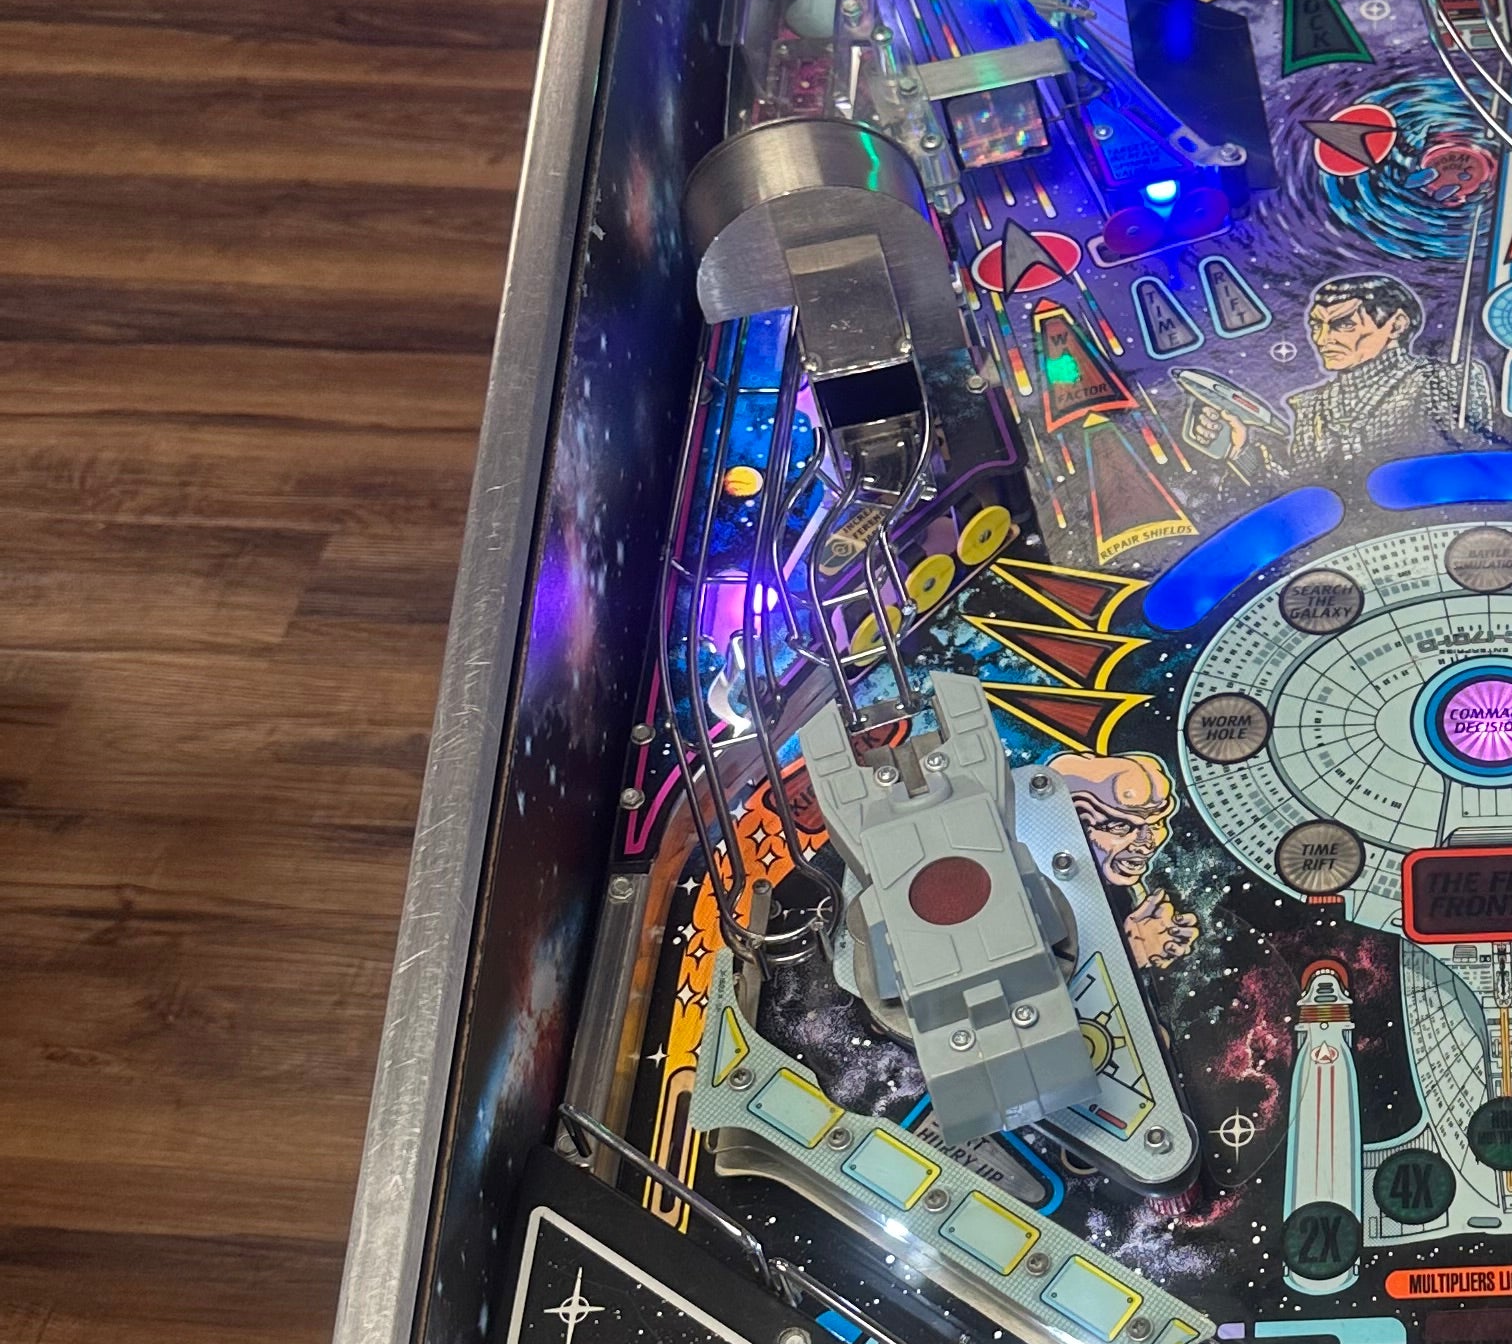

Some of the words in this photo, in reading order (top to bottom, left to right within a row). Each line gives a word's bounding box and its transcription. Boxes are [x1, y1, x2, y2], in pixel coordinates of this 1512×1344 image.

[1215, 271, 1248, 326] RIFT
[1147, 290, 1181, 347] TIME
[1057, 383, 1110, 403] FACTOR
[1100, 536, 1139, 559] REPAIR
[1143, 524, 1193, 540] SHIELDS
[1468, 549, 1508, 558] BATTLE
[1291, 583, 1353, 596] SEARCH
[1307, 596, 1336, 606] THE
[1289, 606, 1351, 619] GALAXY
[1200, 714, 1253, 730] WORM
[1206, 726, 1248, 742] HOLE
[1301, 842, 1340, 858] TIME
[1302, 856, 1338, 872] RIFT
[1427, 871, 1478, 896] THE
[1389, 1161, 1434, 1210] 4X
[1298, 1216, 1343, 1265] 2X
[1410, 1271, 1496, 1292] MULTIPLIERS
